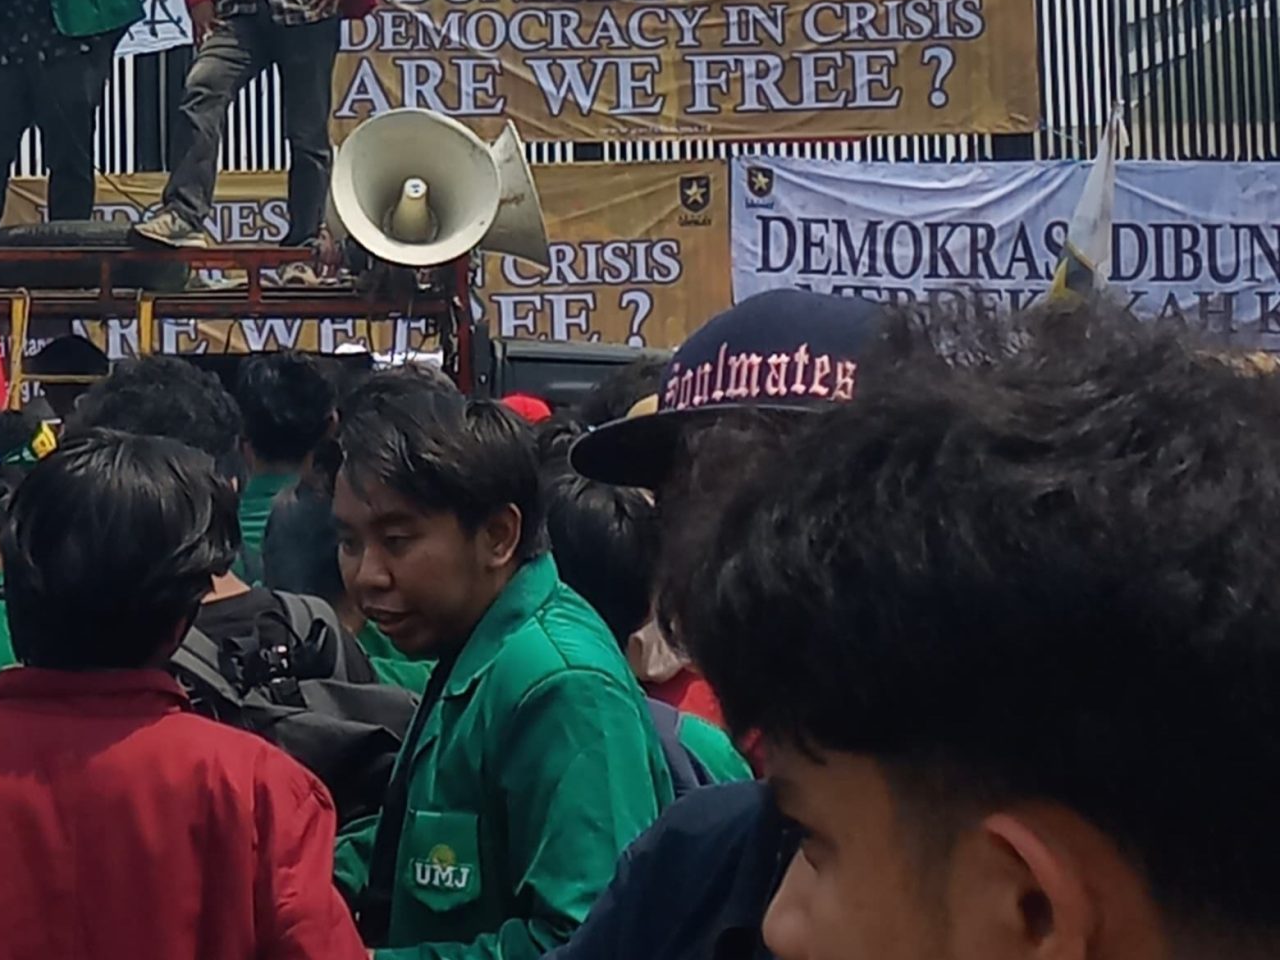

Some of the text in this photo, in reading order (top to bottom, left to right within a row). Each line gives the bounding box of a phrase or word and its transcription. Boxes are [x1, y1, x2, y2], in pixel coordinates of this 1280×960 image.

[338, 6, 702, 54] DEMOCRACY
[721, 1, 790, 46] IN
[334, 42, 958, 119] ARE WE FREE ?
[501, 240, 682, 286] CRISIS
[755, 214, 1070, 282] DEMOKRAS
[620, 289, 653, 348] ?
[415, 862, 470, 888] UMJ
